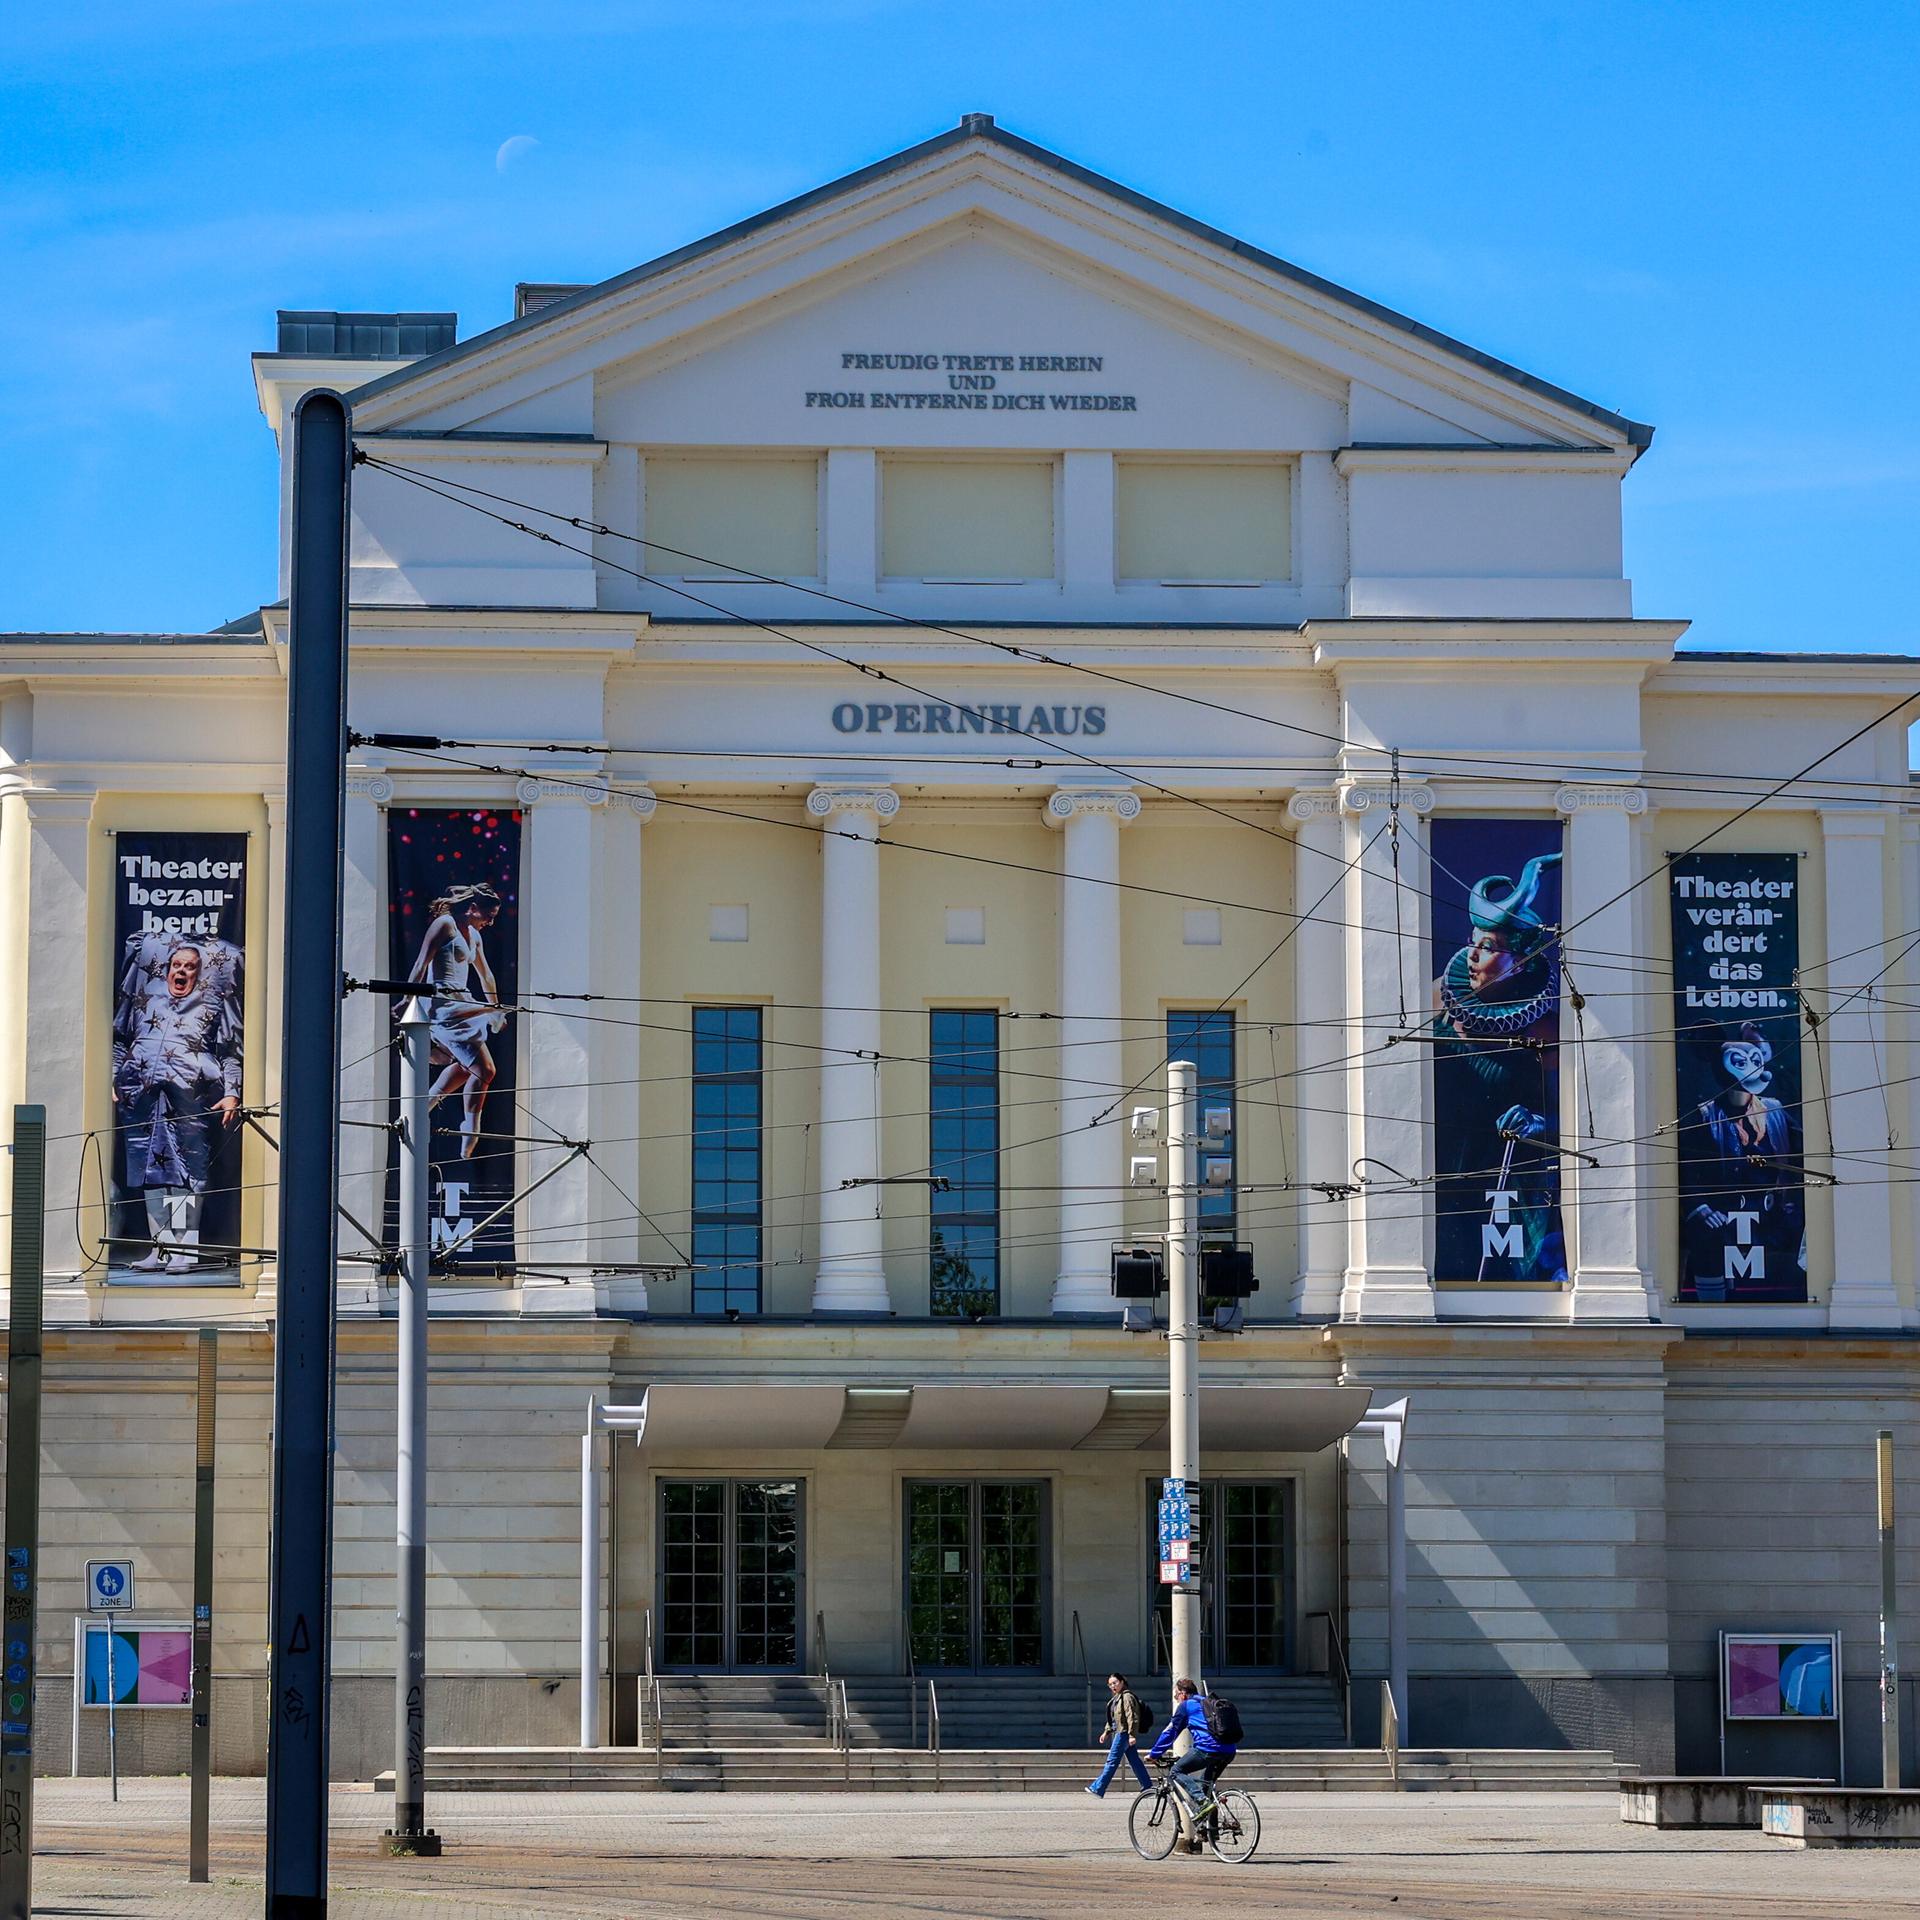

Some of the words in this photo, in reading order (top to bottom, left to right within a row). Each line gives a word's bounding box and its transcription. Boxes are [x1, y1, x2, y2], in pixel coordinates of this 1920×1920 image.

[841, 353, 939, 370] FREUDIG
[943, 355, 1014, 371] TRETE
[1018, 356, 1103, 372] HEREIN
[948, 374, 996, 390] UND
[805, 392, 865, 409] FROH
[870, 393, 988, 410] ENTFERNE
[991, 394, 1045, 411] DICH
[1049, 395, 1137, 411] WIEDER
[831, 703, 1107, 735] OPERNHAUS
[120, 855, 243, 879] Theater
[128, 882, 234, 907] bezau-
[1674, 875, 1794, 899] Theater
[142, 910, 220, 935] bert!
[1686, 902, 1783, 926] verän-
[1702, 930, 1768, 953] dert
[1708, 957, 1763, 981] das
[1686, 985, 1788, 1008] Leben.
[99, 1597, 122, 1607] ZONE
